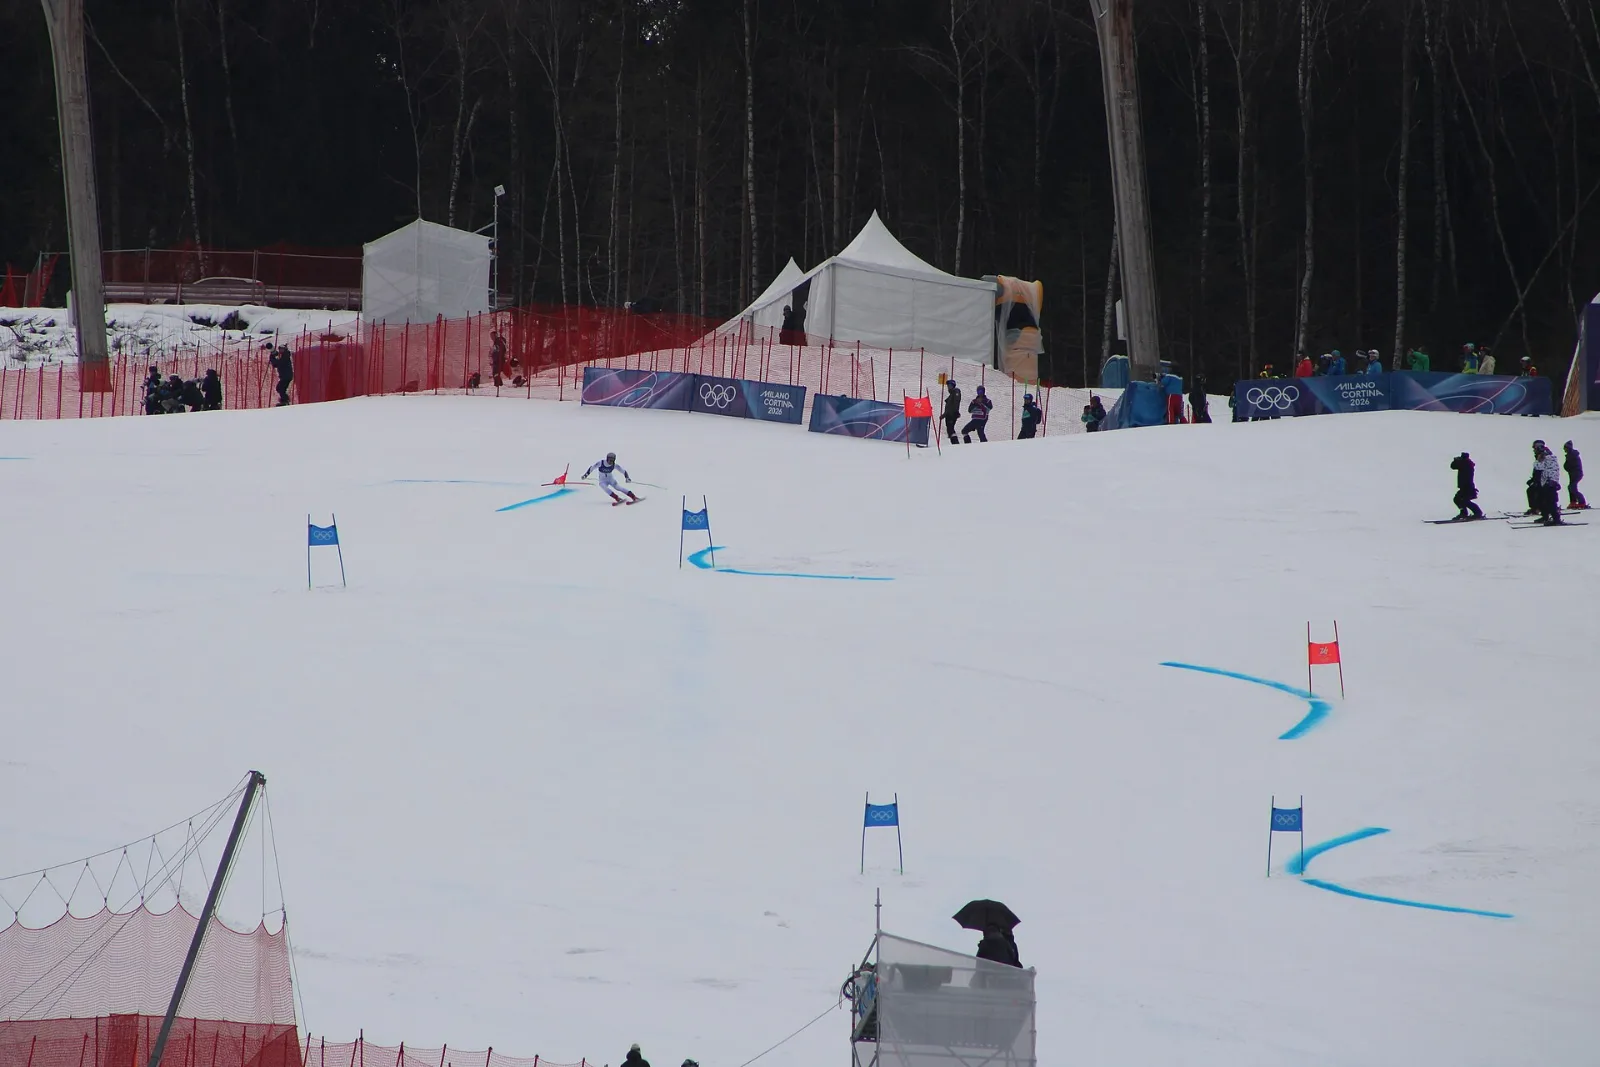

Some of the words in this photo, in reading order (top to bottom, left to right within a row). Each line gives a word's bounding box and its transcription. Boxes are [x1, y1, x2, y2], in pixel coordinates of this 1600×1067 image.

[1334, 382, 1376, 390] MILANO
[760, 390, 790, 400] MILANO
[1342, 390, 1384, 398] CORTINA
[764, 399, 794, 408] CORTINA
[1350, 398, 1370, 406] 2026
